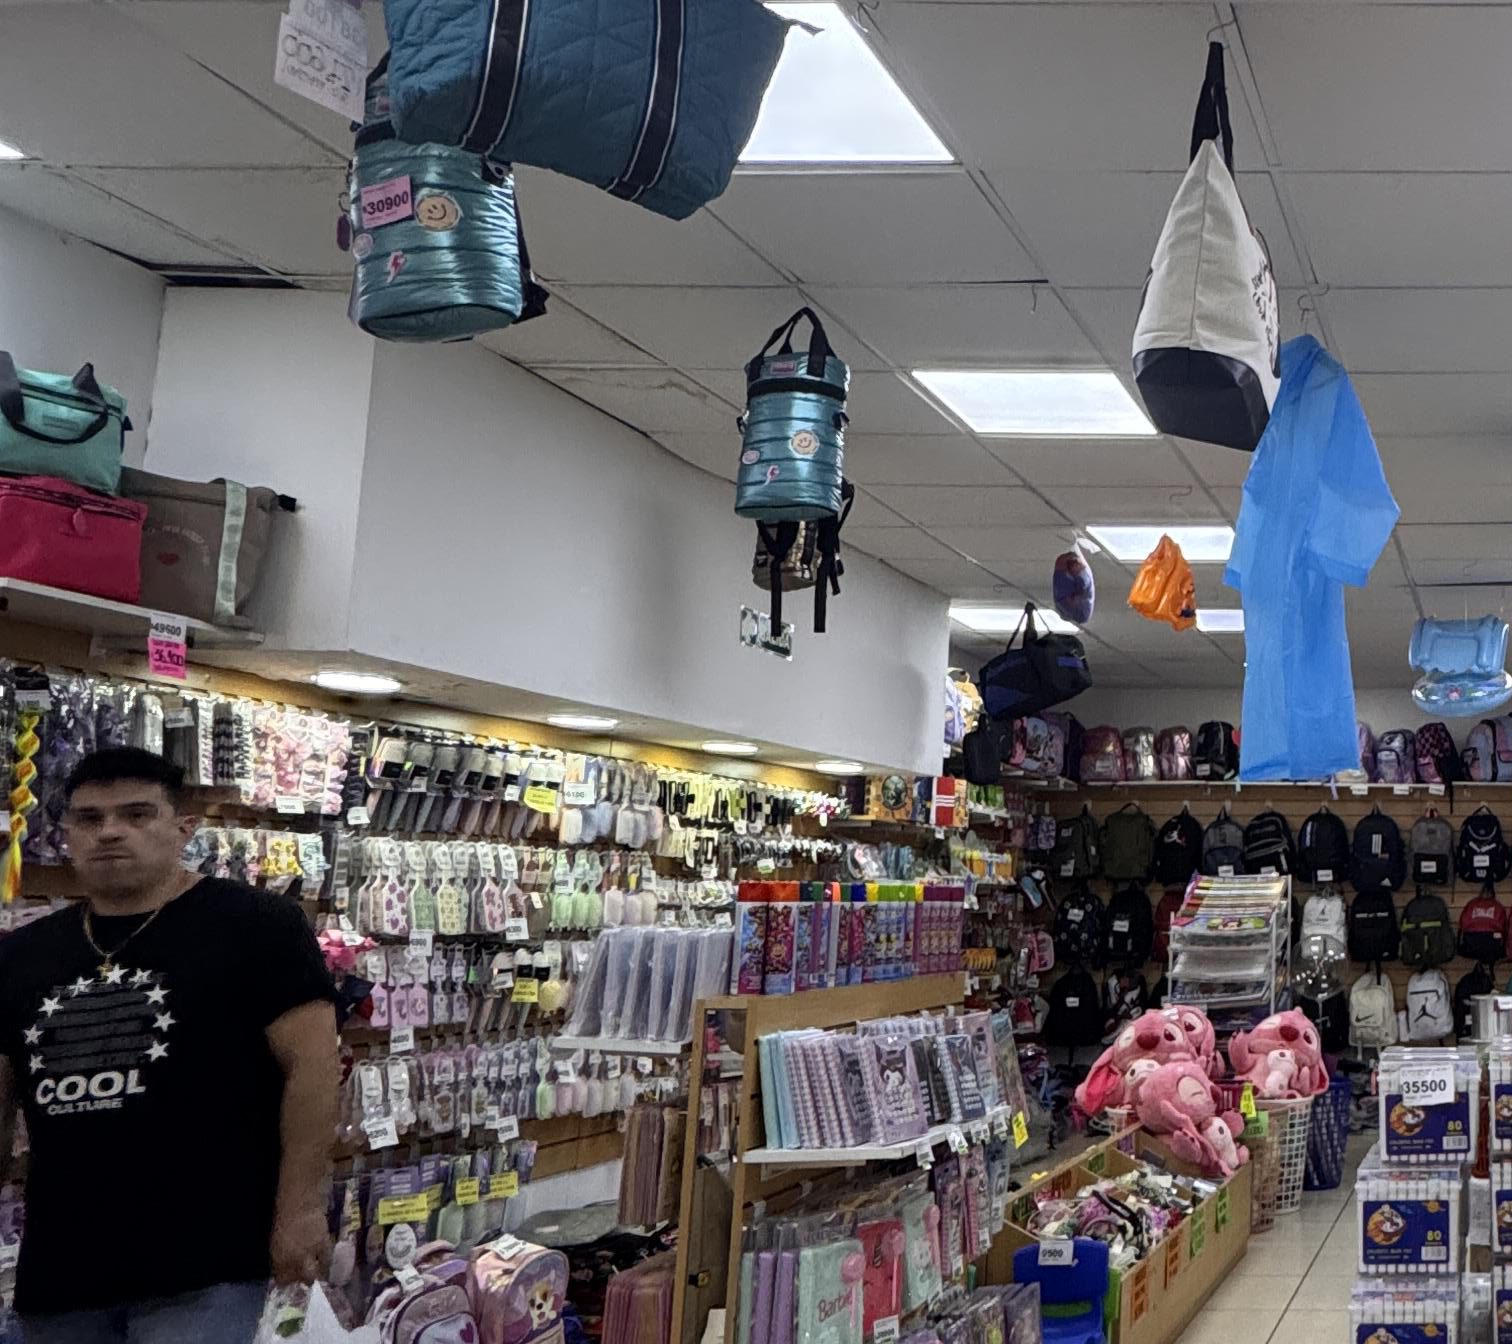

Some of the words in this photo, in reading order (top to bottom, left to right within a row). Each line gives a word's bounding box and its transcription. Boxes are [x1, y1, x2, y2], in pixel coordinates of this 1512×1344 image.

[35, 1068, 147, 1105] COOL
[47, 1097, 124, 1116] CULTURE
[1447, 1120, 1463, 1132] 80
[1426, 1230, 1442, 1242] 80
